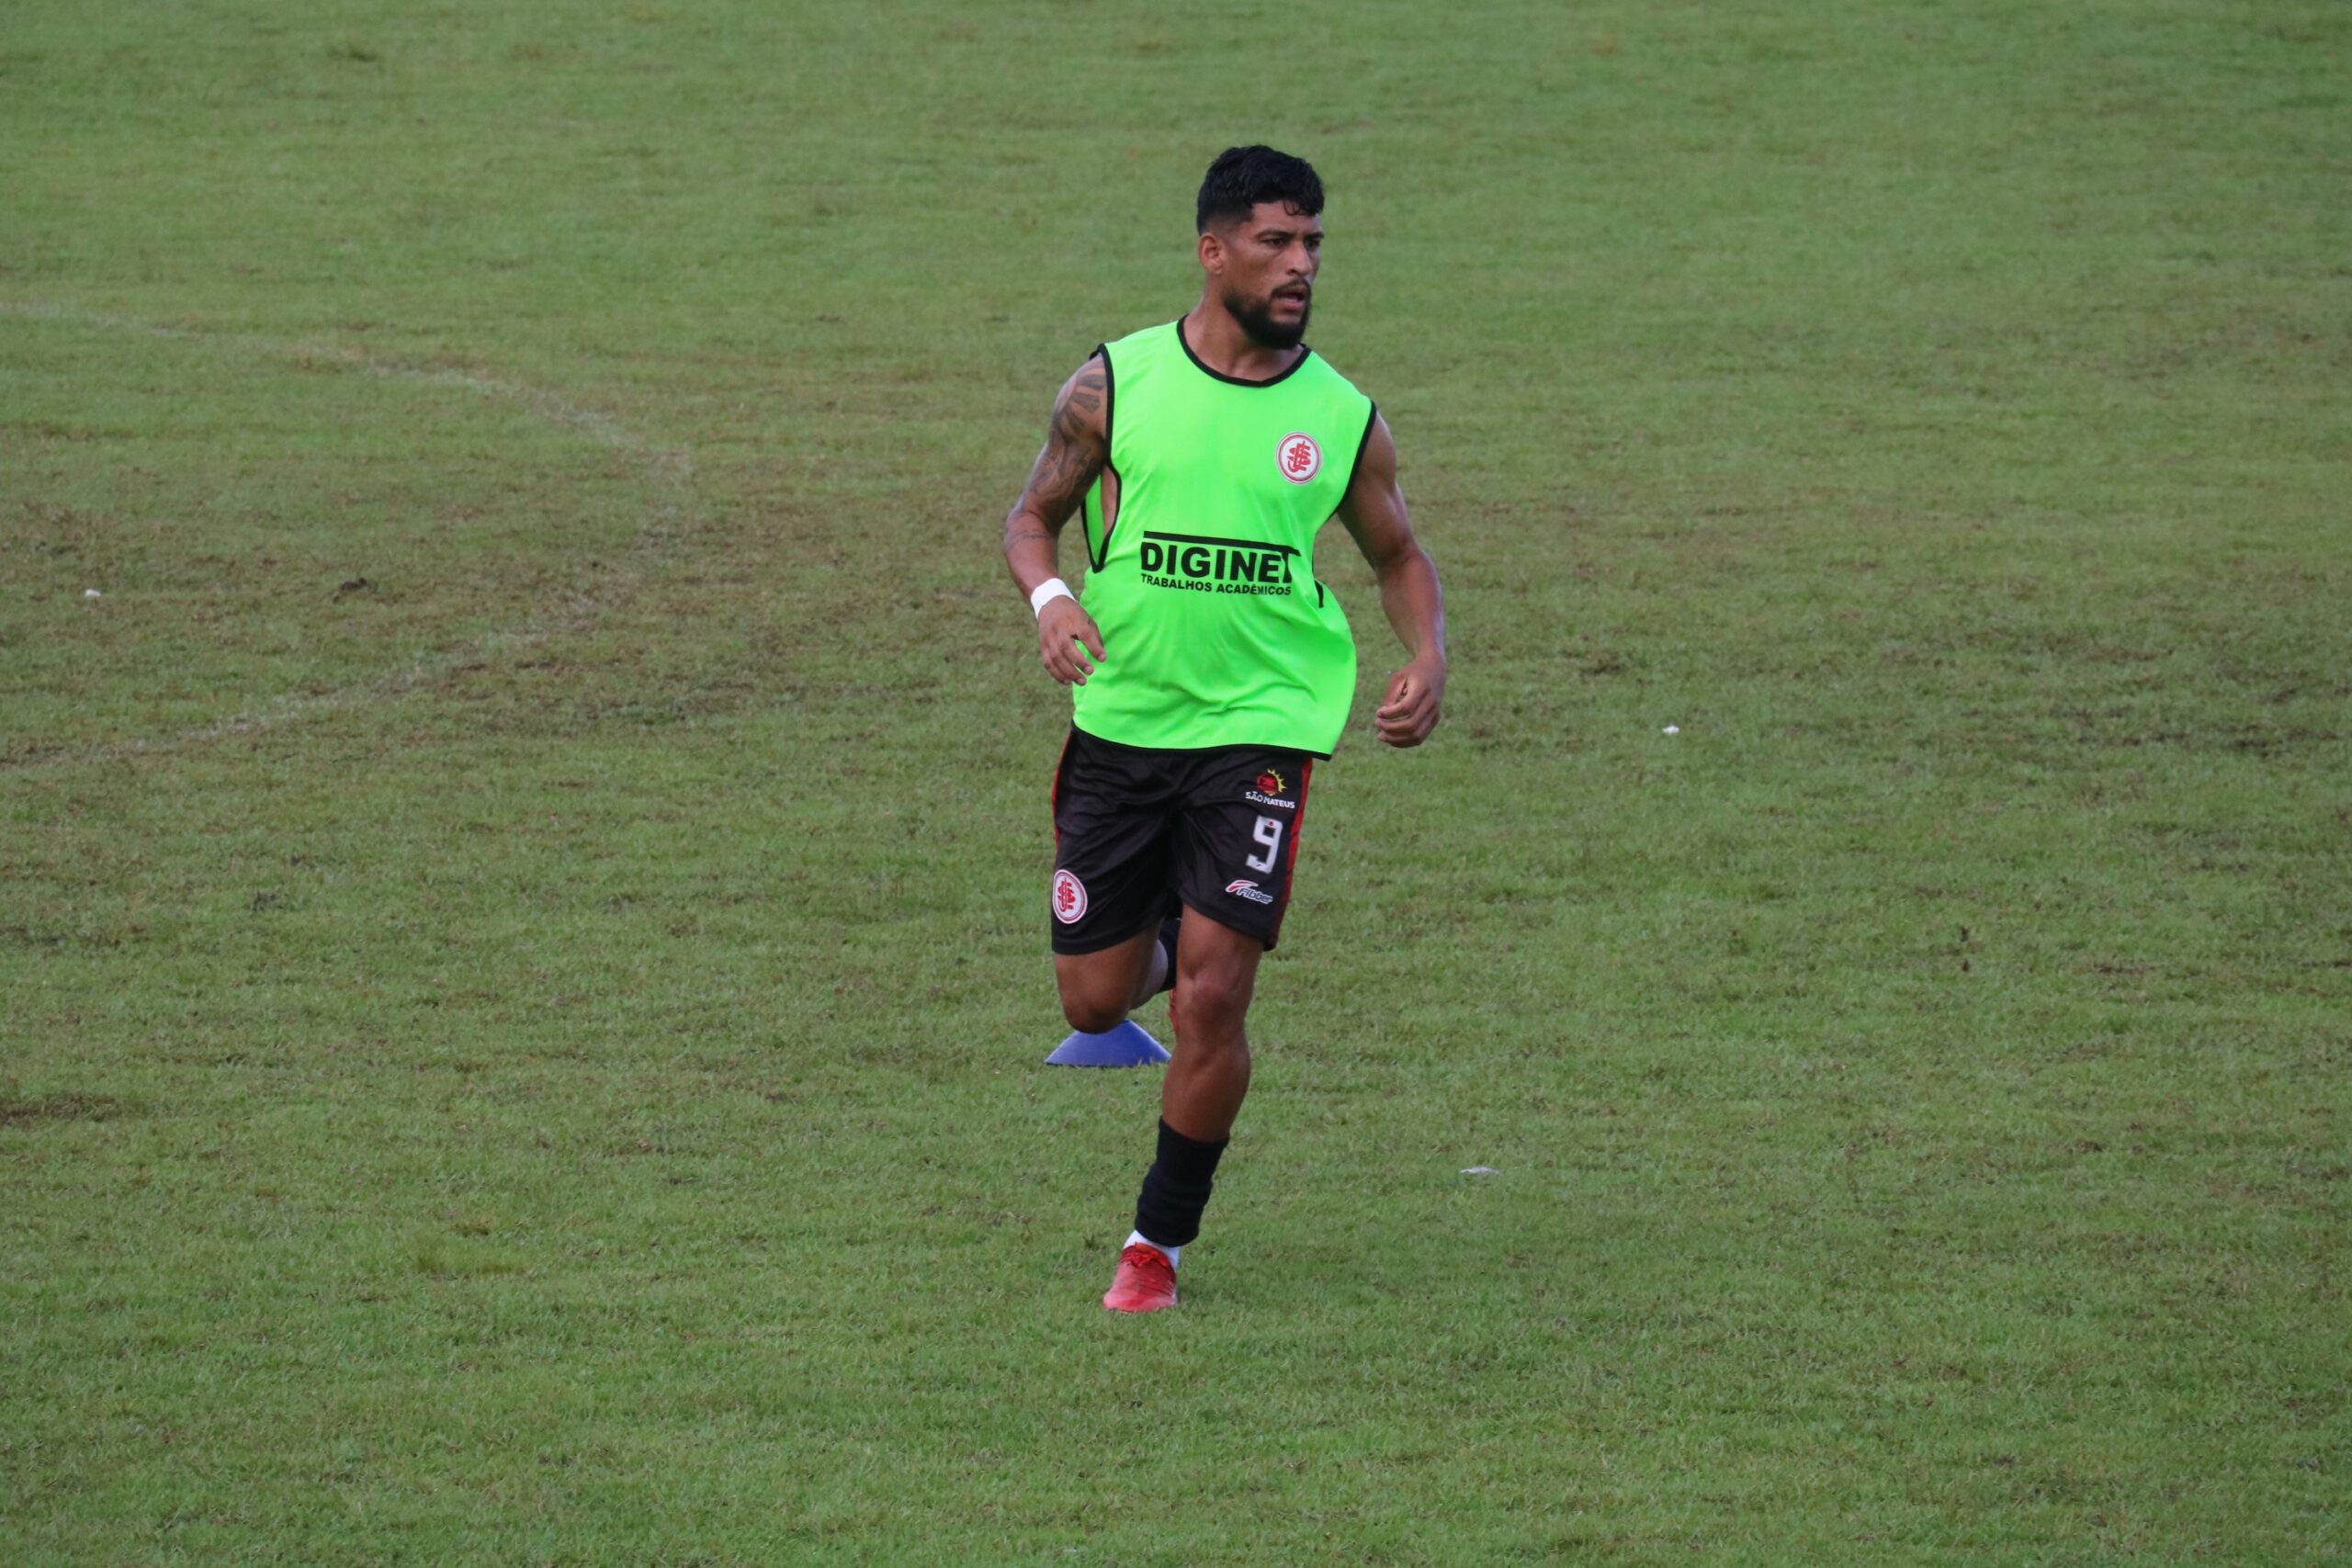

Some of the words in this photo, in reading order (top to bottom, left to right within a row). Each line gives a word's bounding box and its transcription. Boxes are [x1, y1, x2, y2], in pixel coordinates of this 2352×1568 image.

[1140, 533, 1300, 583] DIGINET
[1140, 573, 1213, 592] TRABALHOS
[1245, 790, 1263, 803] SÃO
[1263, 796, 1295, 809] MATEUS
[1245, 815, 1283, 874] 9
